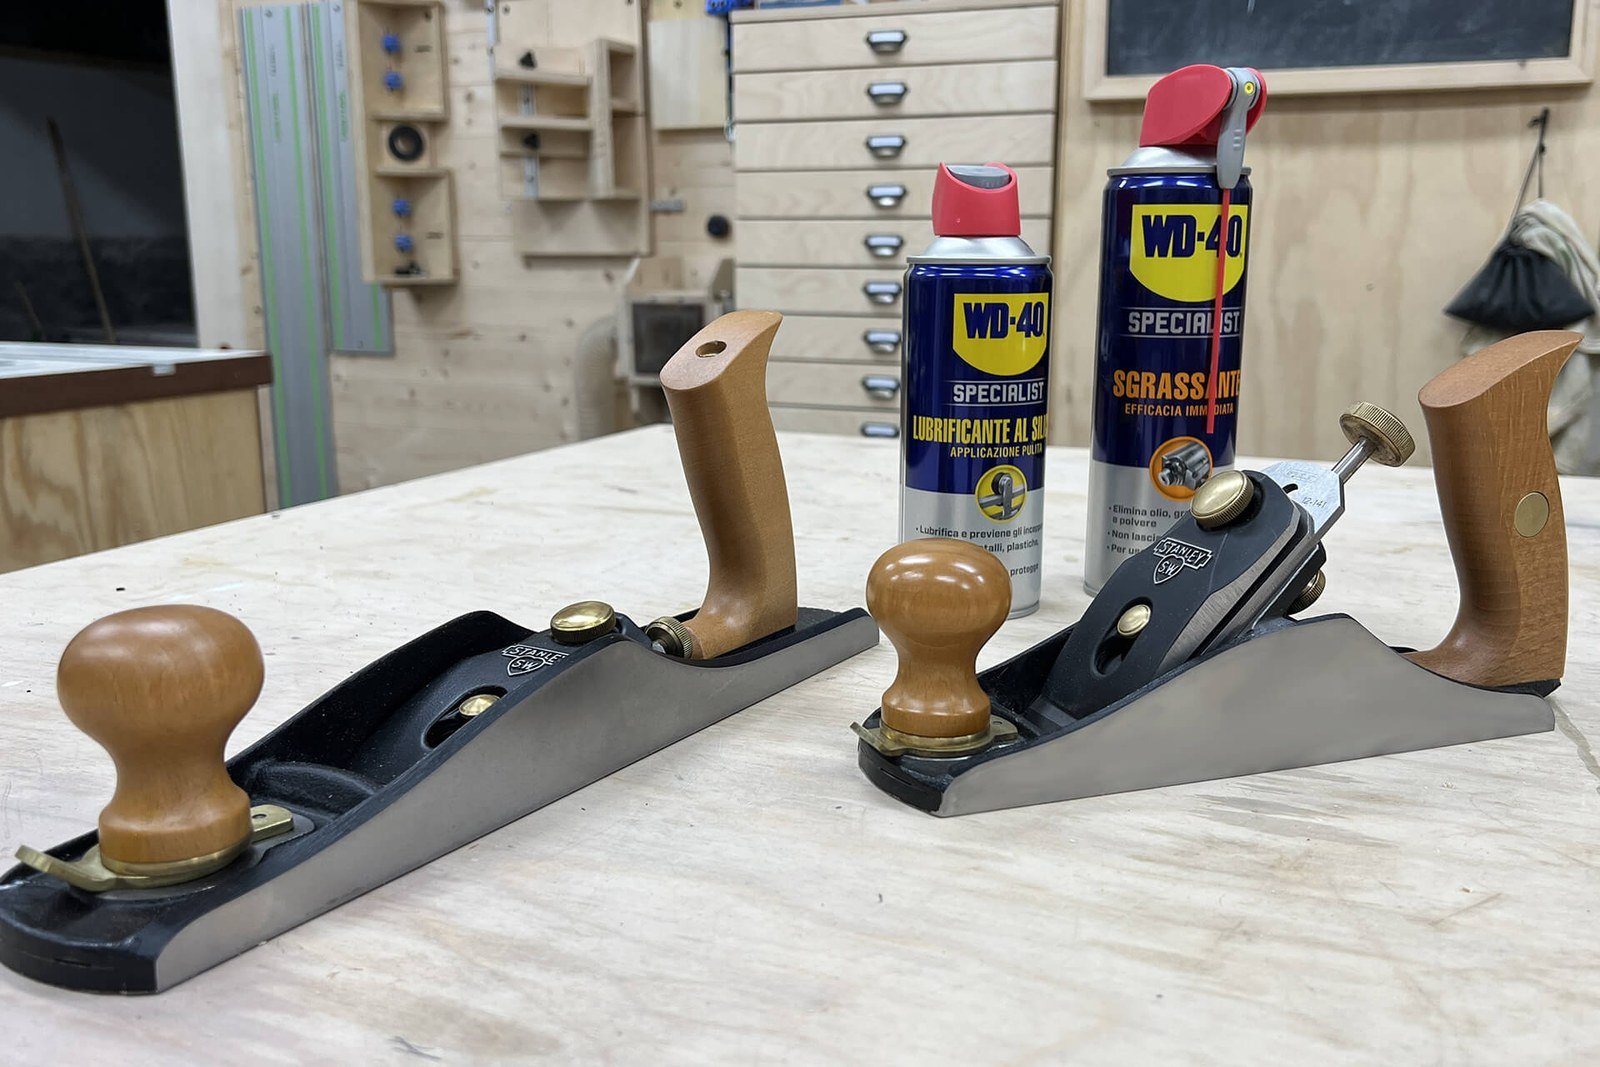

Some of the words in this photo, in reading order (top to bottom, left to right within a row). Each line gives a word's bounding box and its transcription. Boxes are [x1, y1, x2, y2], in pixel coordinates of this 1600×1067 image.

[1141, 214, 1242, 258] WD-40
[962, 301, 1045, 339] WD-40
[953, 382, 1044, 403] SPECIALIST
[1125, 403, 1182, 416] EFFICACIA
[1186, 403, 1234, 416] IMMDIATA
[913, 415, 1010, 444] LUBRIFICANTE
[1013, 418, 1029, 442] AL
[950, 446, 1020, 458] APPLICAZIONE
[1022, 443, 1043, 456] PULITA
[1112, 504, 1147, 516] Elimina
[1149, 508, 1172, 518] olio,
[1120, 517, 1157, 527] polvere
[920, 525, 959, 538] Lubrifica
[961, 530, 968, 538] e
[970, 528, 1012, 540] previene
[1013, 526, 1023, 537] gli
[1111, 529, 1130, 539] Non
[1111, 543, 1127, 553] Per
[1158, 541, 1206, 564] STANLEY
[509, 646, 566, 663] STANLE
